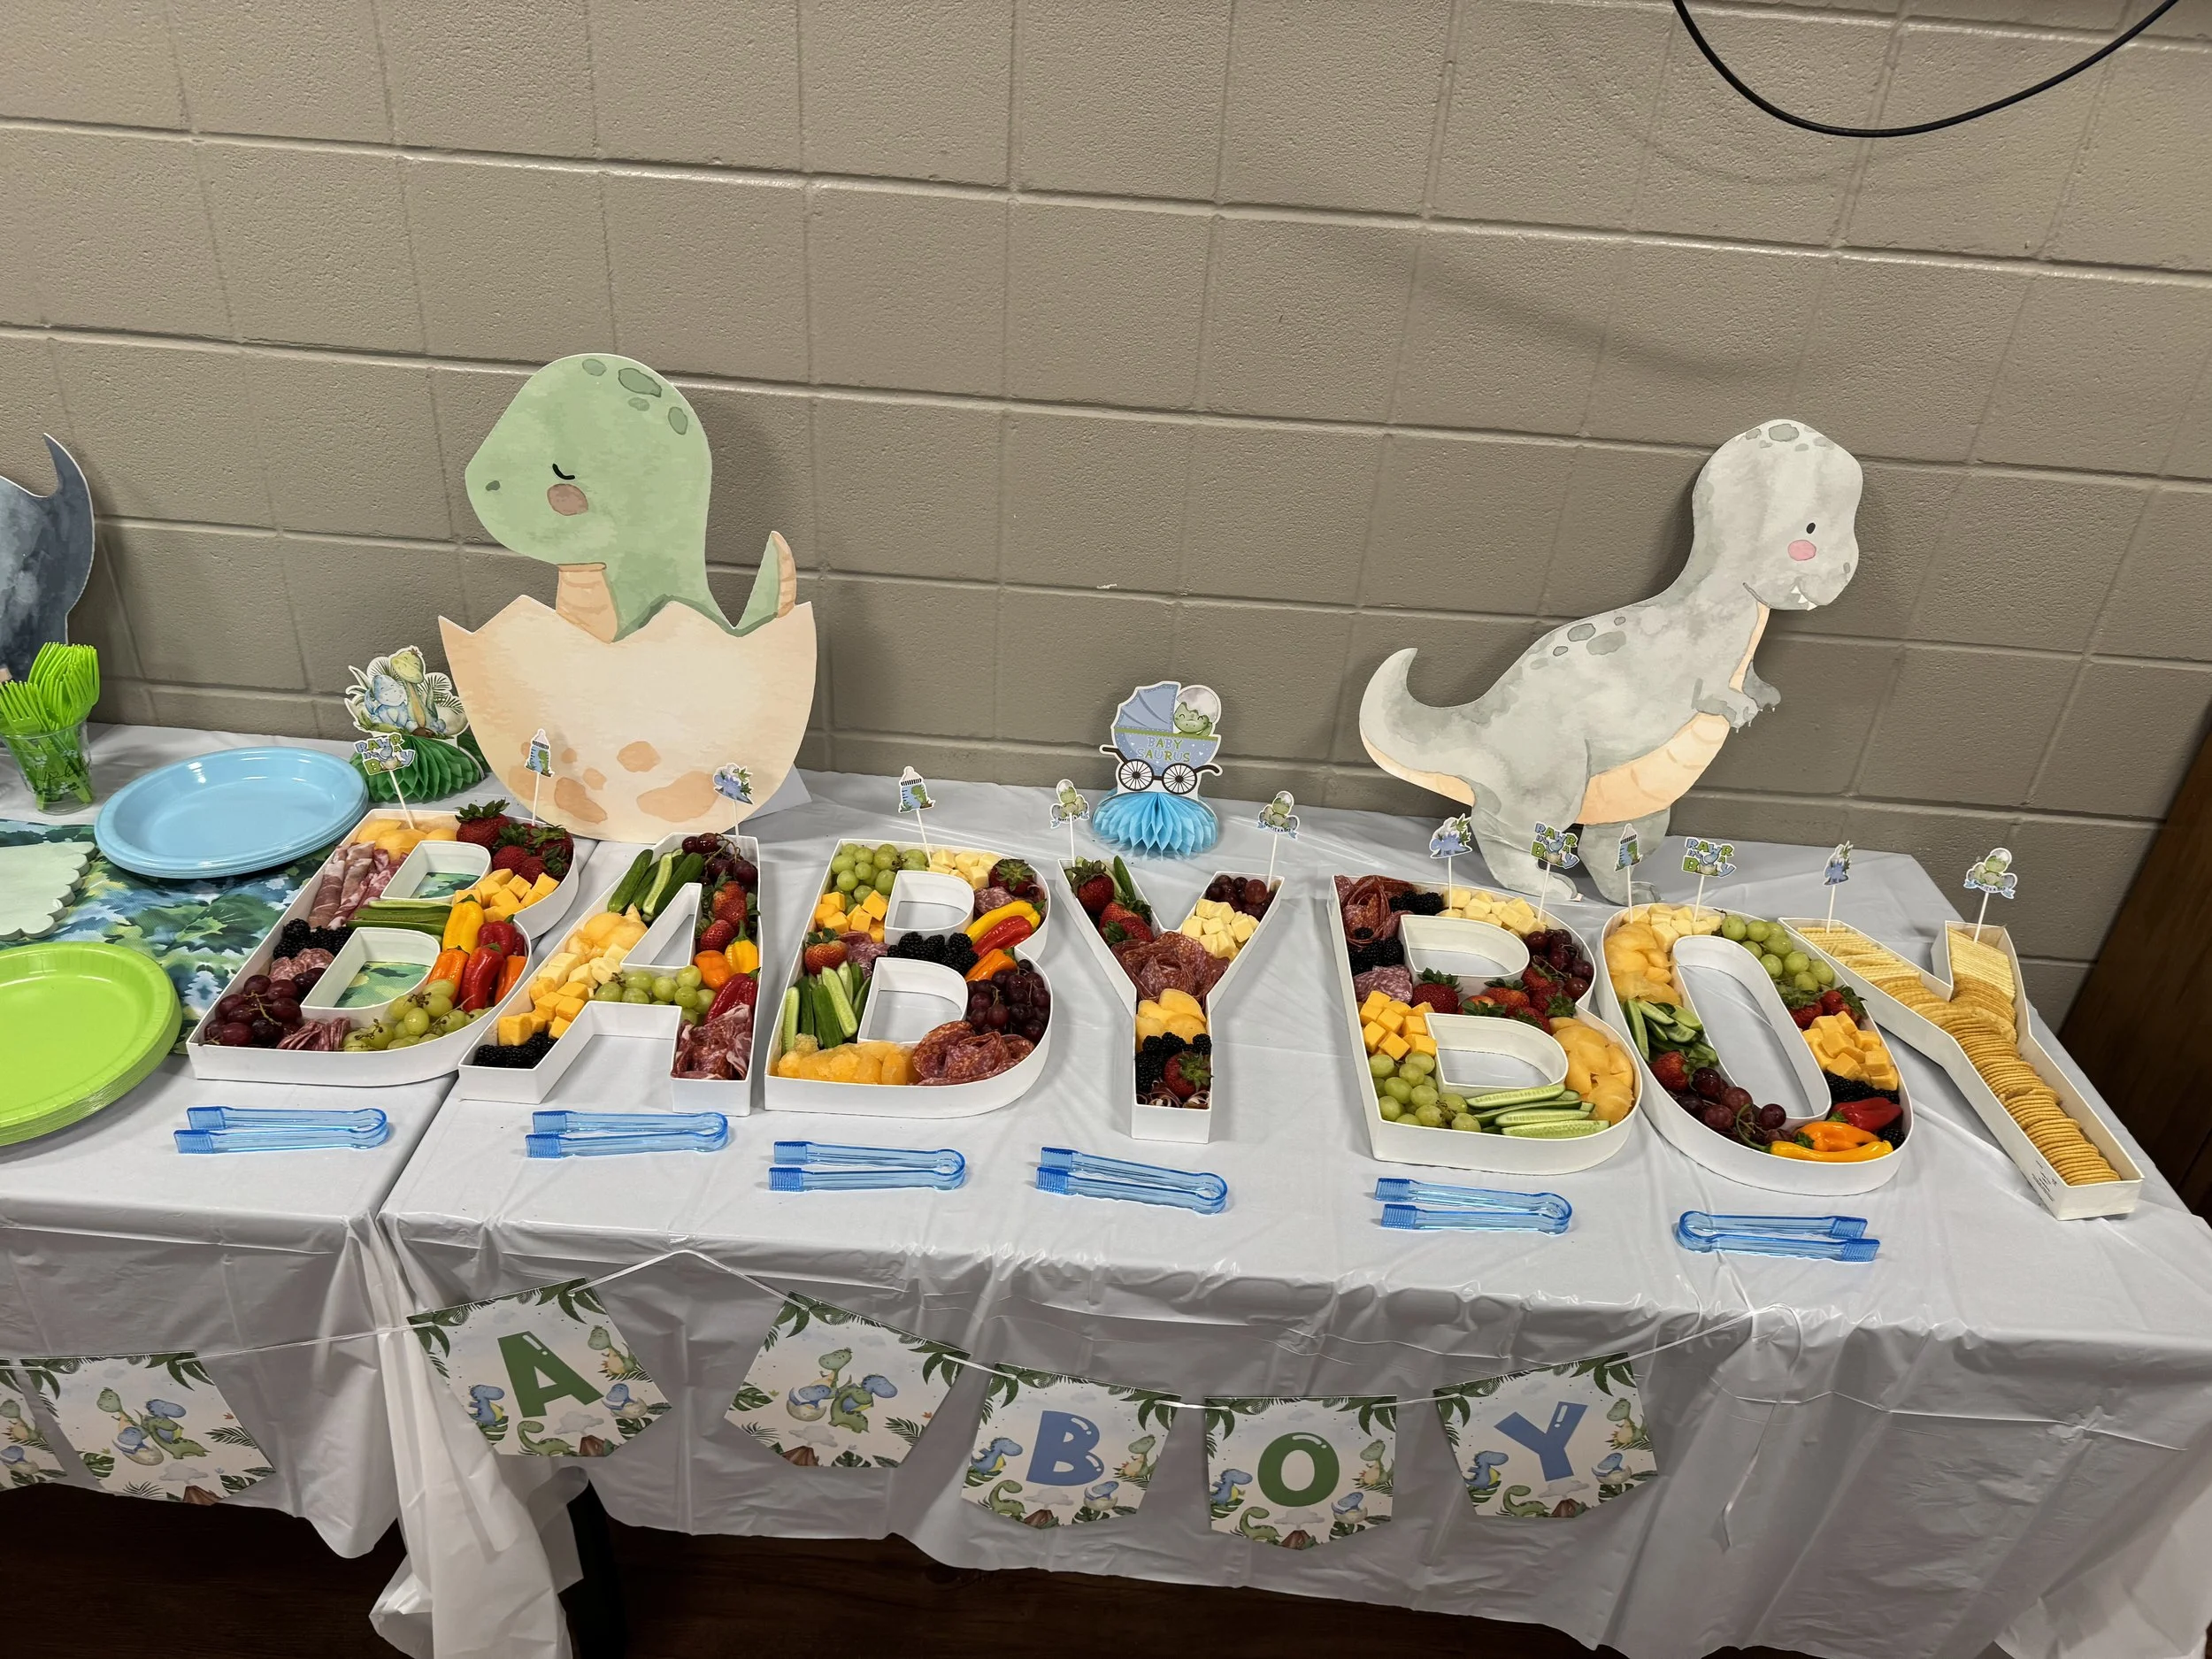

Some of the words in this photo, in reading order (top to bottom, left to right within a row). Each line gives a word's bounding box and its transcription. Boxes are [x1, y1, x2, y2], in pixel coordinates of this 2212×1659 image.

[355, 733, 403, 753] RAWR
[1147, 736, 1183, 749] BABY
[1137, 748, 1191, 763] SAURUS
[1535, 823, 1578, 847] RAWR
[1686, 838, 1734, 856] RAWR
[497, 1331, 604, 1417] A
